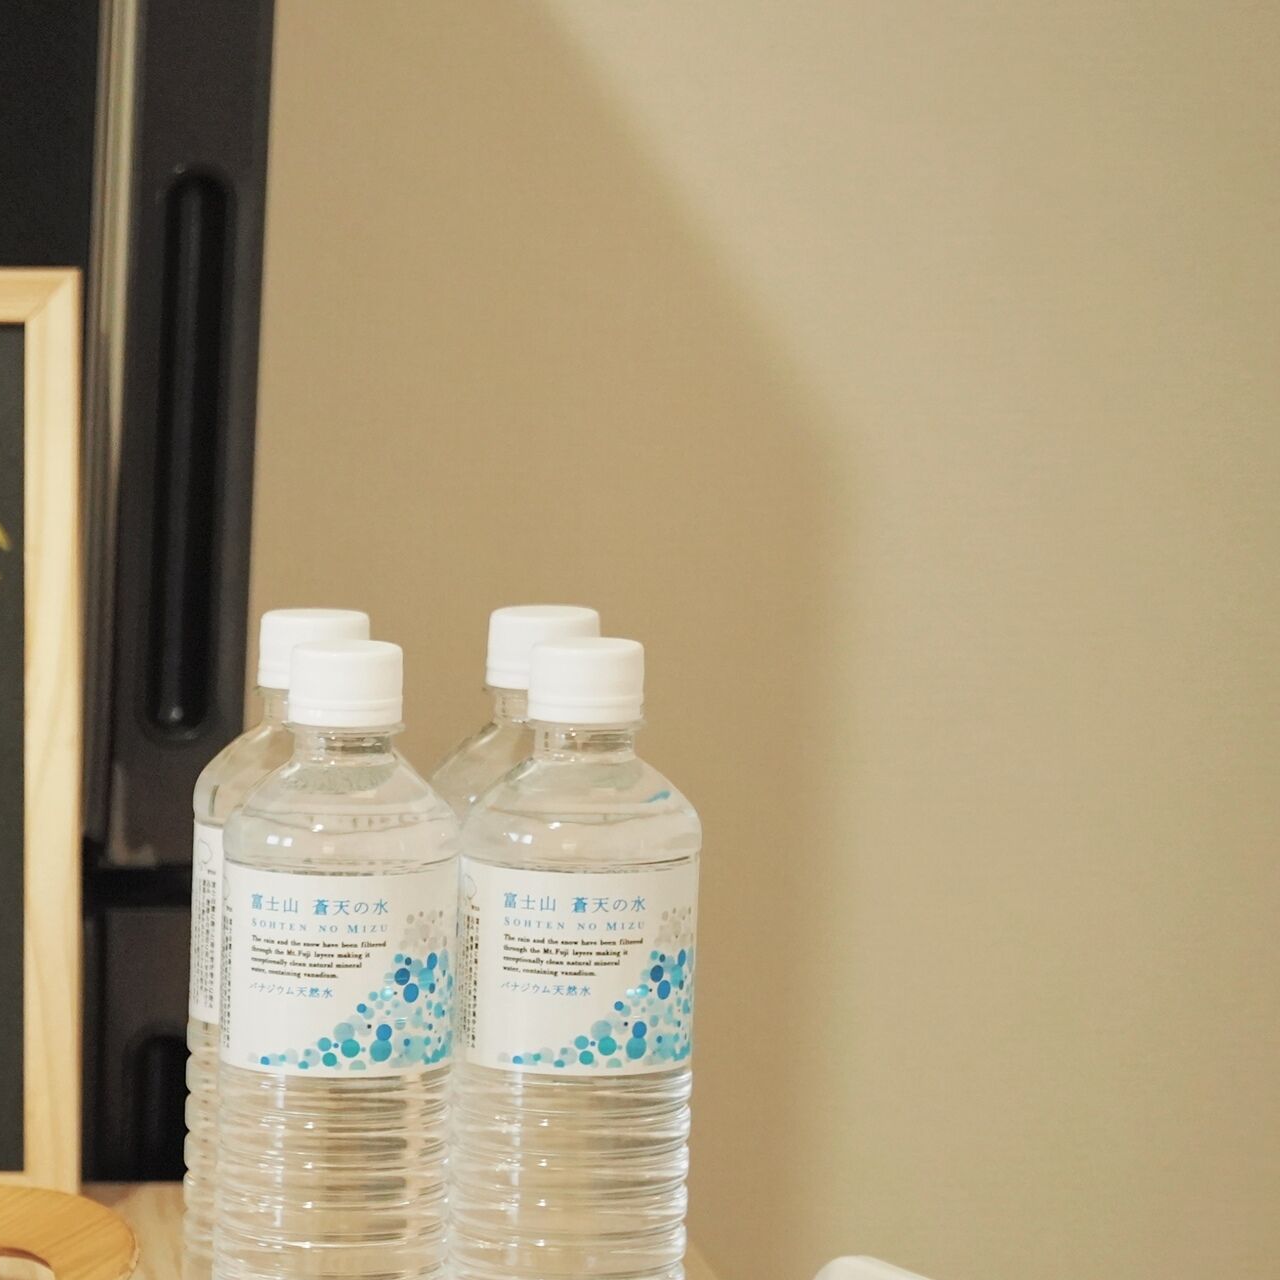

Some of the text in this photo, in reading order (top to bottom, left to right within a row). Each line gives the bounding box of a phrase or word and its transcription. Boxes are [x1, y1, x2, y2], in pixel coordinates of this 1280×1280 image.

[251, 893, 389, 916] 富士山 蒼天の水
[503, 892, 646, 914] 富士山 蒼天の水
